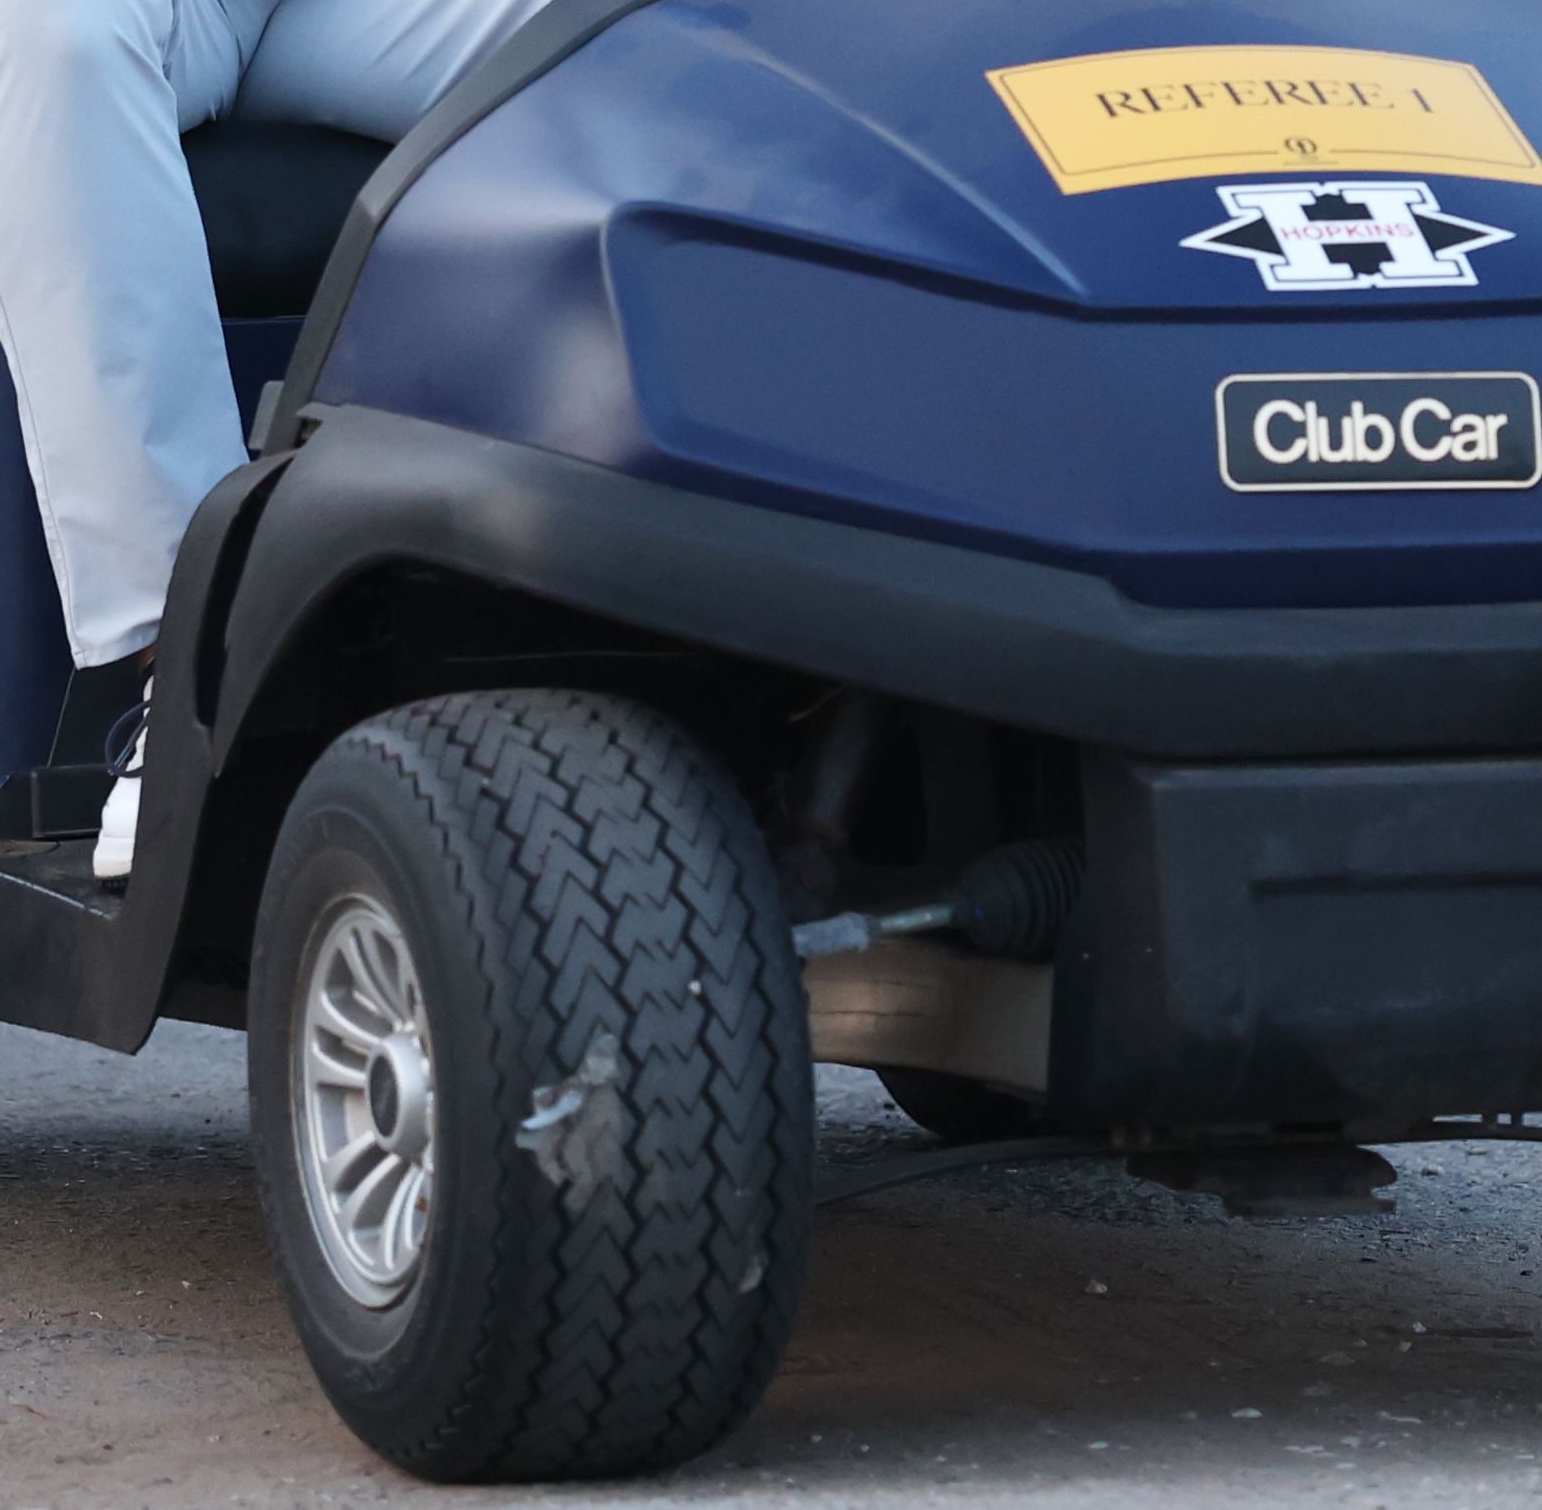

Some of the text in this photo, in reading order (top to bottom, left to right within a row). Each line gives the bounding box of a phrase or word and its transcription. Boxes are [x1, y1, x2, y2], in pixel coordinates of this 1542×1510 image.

[1096, 80, 1395, 118] REFEREE
[1280, 222, 1415, 241] HOPKINS
[1253, 397, 1508, 464] Club Car
